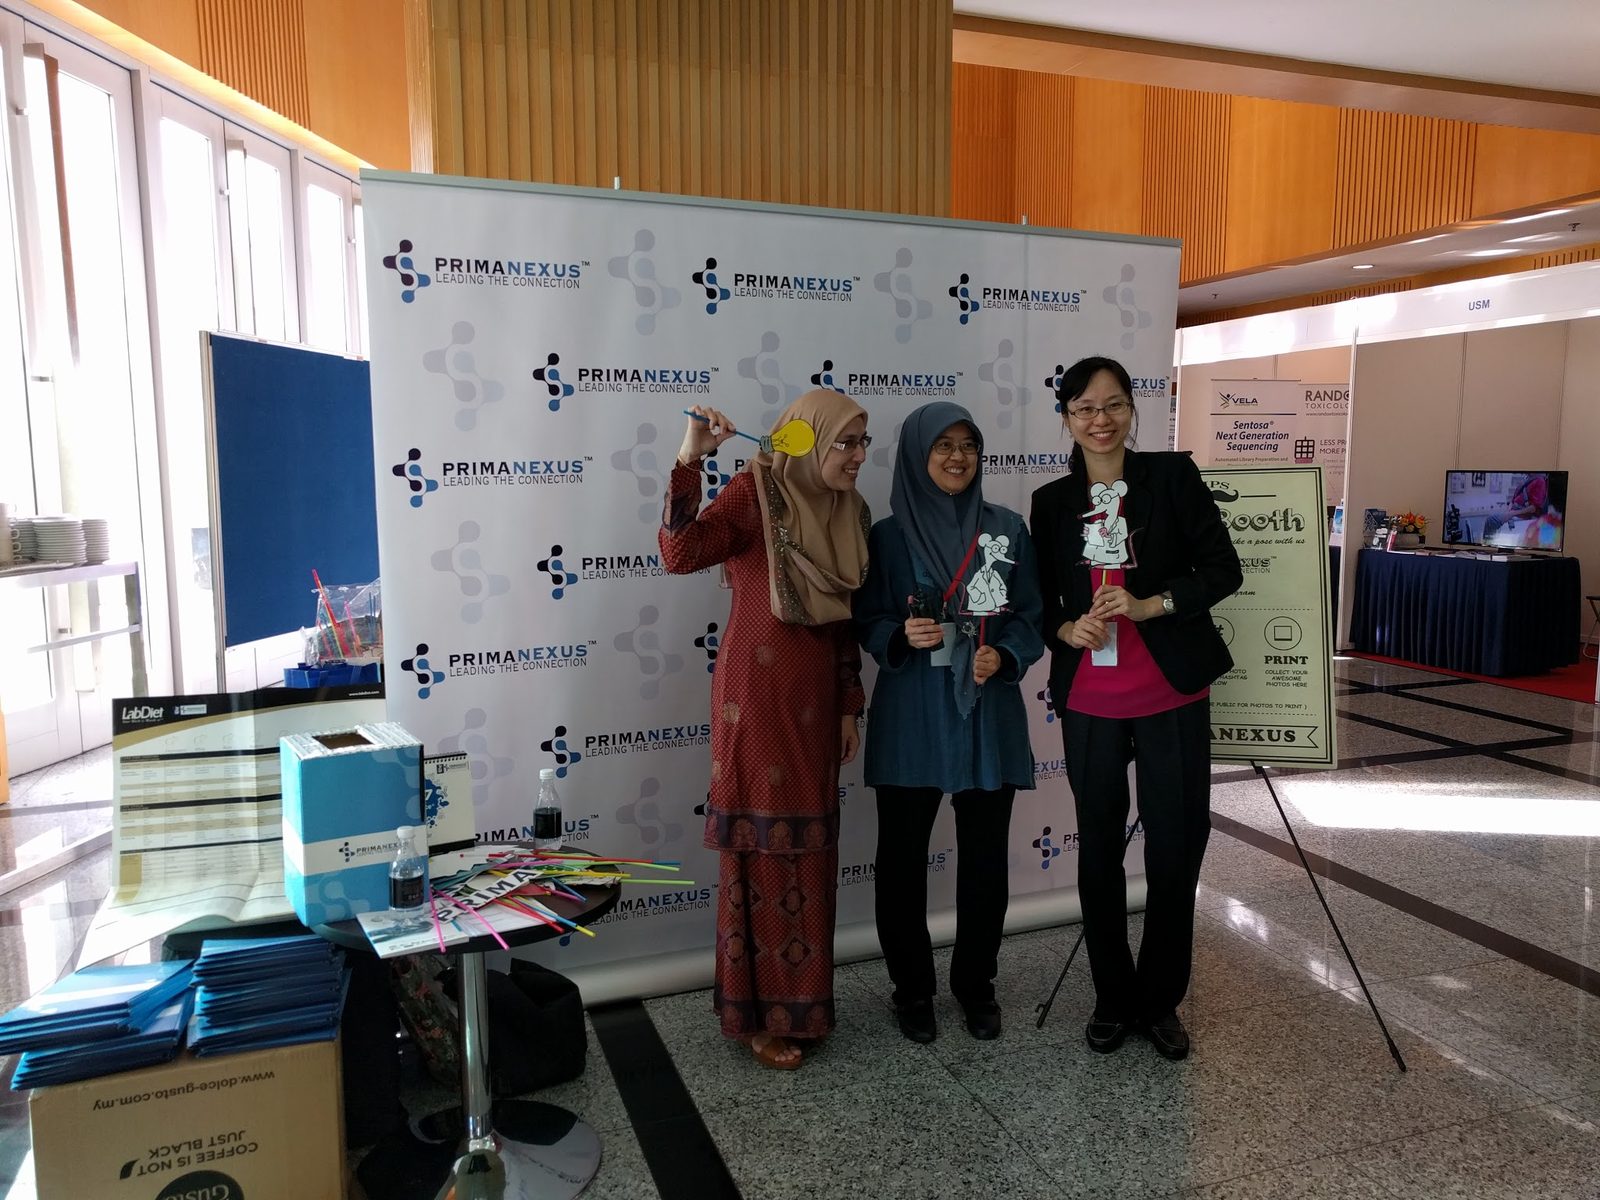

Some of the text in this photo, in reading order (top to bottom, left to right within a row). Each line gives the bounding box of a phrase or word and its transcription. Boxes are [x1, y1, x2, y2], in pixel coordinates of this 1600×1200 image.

[436, 273, 580, 289] LEADING THE CONNECTION
[734, 287, 852, 302] LEADING THE CONNECTION
[983, 300, 1080, 313] LEADING THE CONNECTION
[1468, 299, 1490, 311] USM
[578, 382, 710, 394] LEADING THE CONNECTION
[848, 386, 955, 396] LEADING THE CONNECTION
[1215, 430, 1289, 440] Next Generation
[1226, 441, 1278, 453] Sequencing
[1014, 466, 1028, 474] THE
[443, 474, 583, 487] LEADING THE CONNECTION
[1254, 539, 1272, 547] pose
[1275, 537, 1293, 545] with
[582, 569, 626, 580] LEADING
[629, 568, 648, 578] THE
[1264, 655, 1309, 665] PRINT
[450, 657, 587, 677] LEADING THE CONNECTION
[121, 705, 164, 720] LabDiet
[586, 736, 711, 758] LEADING THE CONNECTION
[631, 908, 649, 918] THE
[652, 900, 710, 915] CONNECTION
[93, 1070, 275, 1111] www.dolce-gusto.com.my
[149, 1129, 246, 1159] JUST BLACK
[137, 1141, 259, 1177] COFFEE IS NOT
